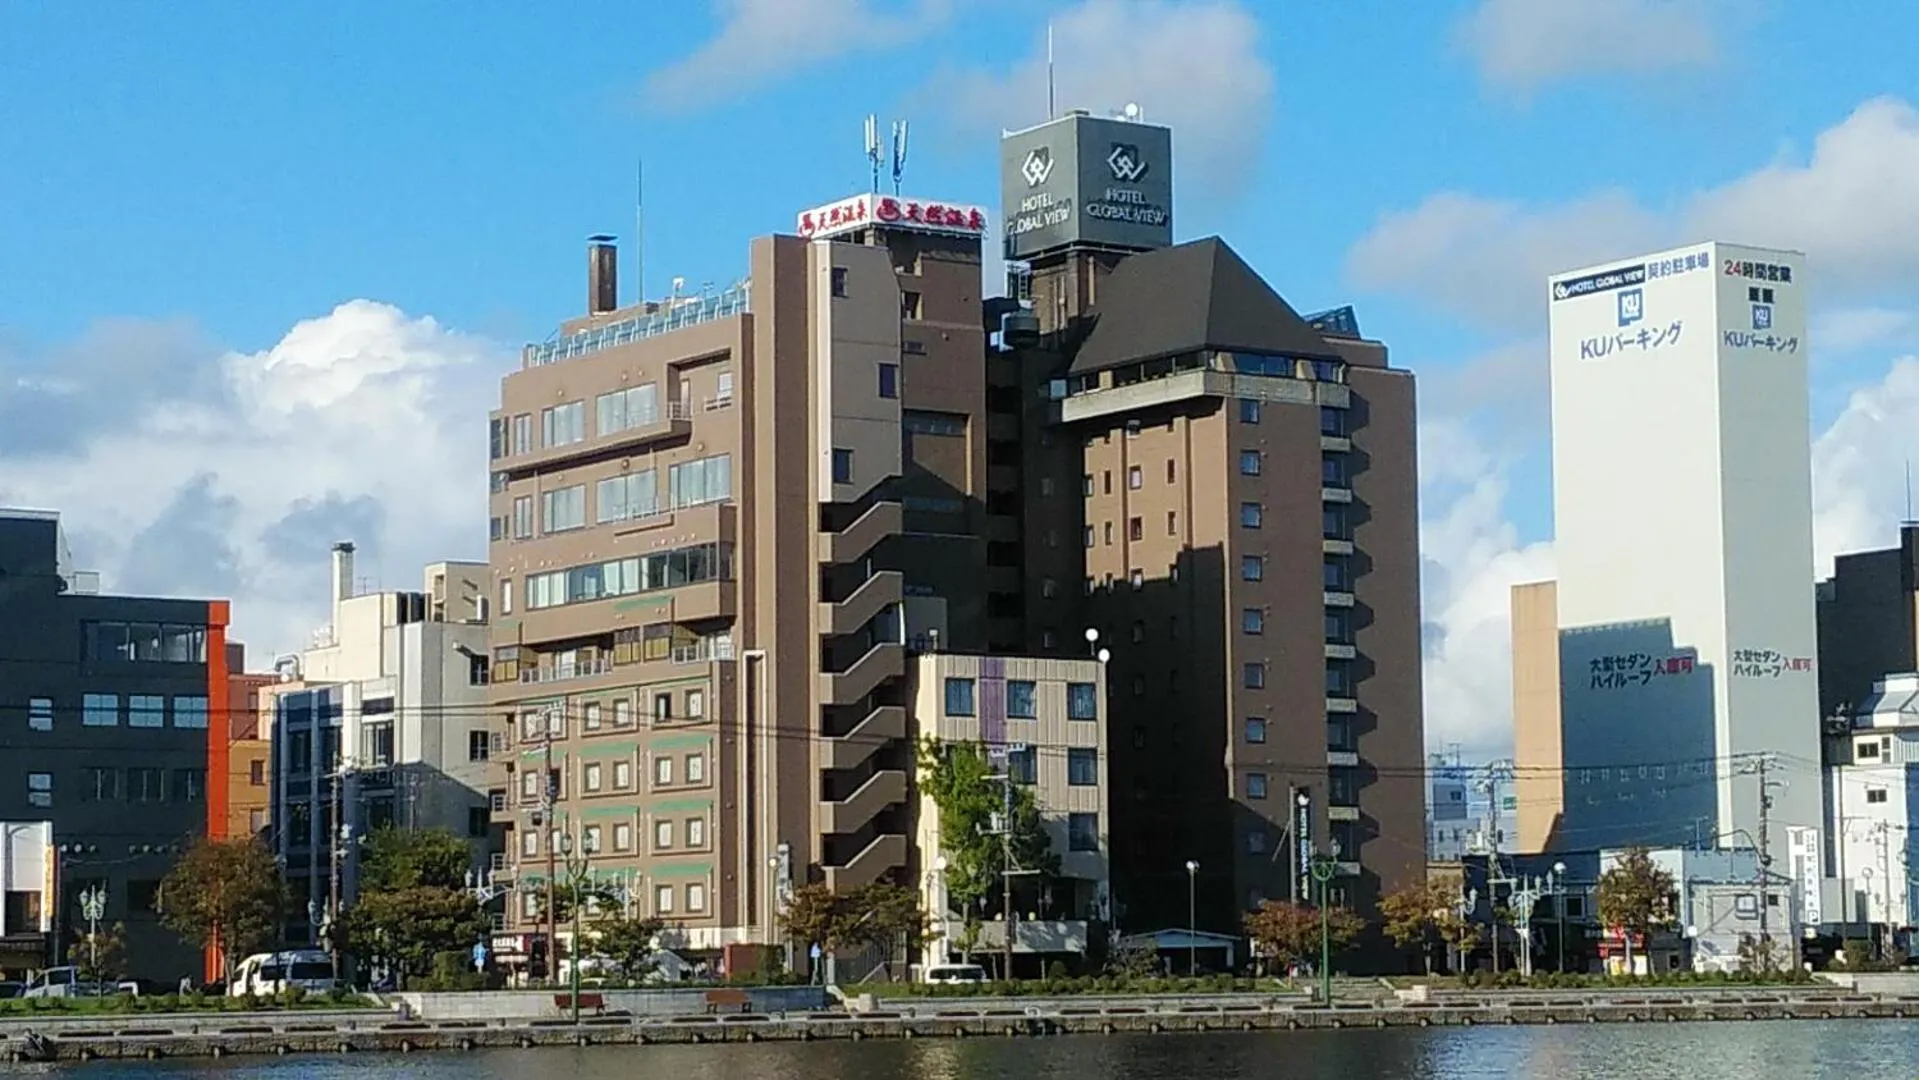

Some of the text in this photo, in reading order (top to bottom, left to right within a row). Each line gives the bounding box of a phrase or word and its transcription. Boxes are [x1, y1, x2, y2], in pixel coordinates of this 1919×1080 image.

[1021, 193, 1053, 212] HOTEL
[1106, 188, 1145, 204] HOTEL
[906, 203, 982, 230] 天然温泉
[1044, 206, 1070, 226] VIEW
[1086, 203, 1166, 226] GLOBAL VIEW
[1648, 252, 1710, 280] 契約駐車場
[1724, 260, 1792, 283] 24時間営業
[1571, 269, 1644, 294] HOTEL GLOBAL VIEW
[1621, 293, 1640, 313] KU
[1580, 320, 1682, 359] KUパーキング
[1723, 330, 1798, 354] KUパーキング
[1589, 653, 1652, 673] 大型セダン
[1734, 649, 1781, 663] 大型セダン
[1590, 669, 1652, 689] ハイルーフ
[1733, 664, 1781, 678] ハイルーフ
